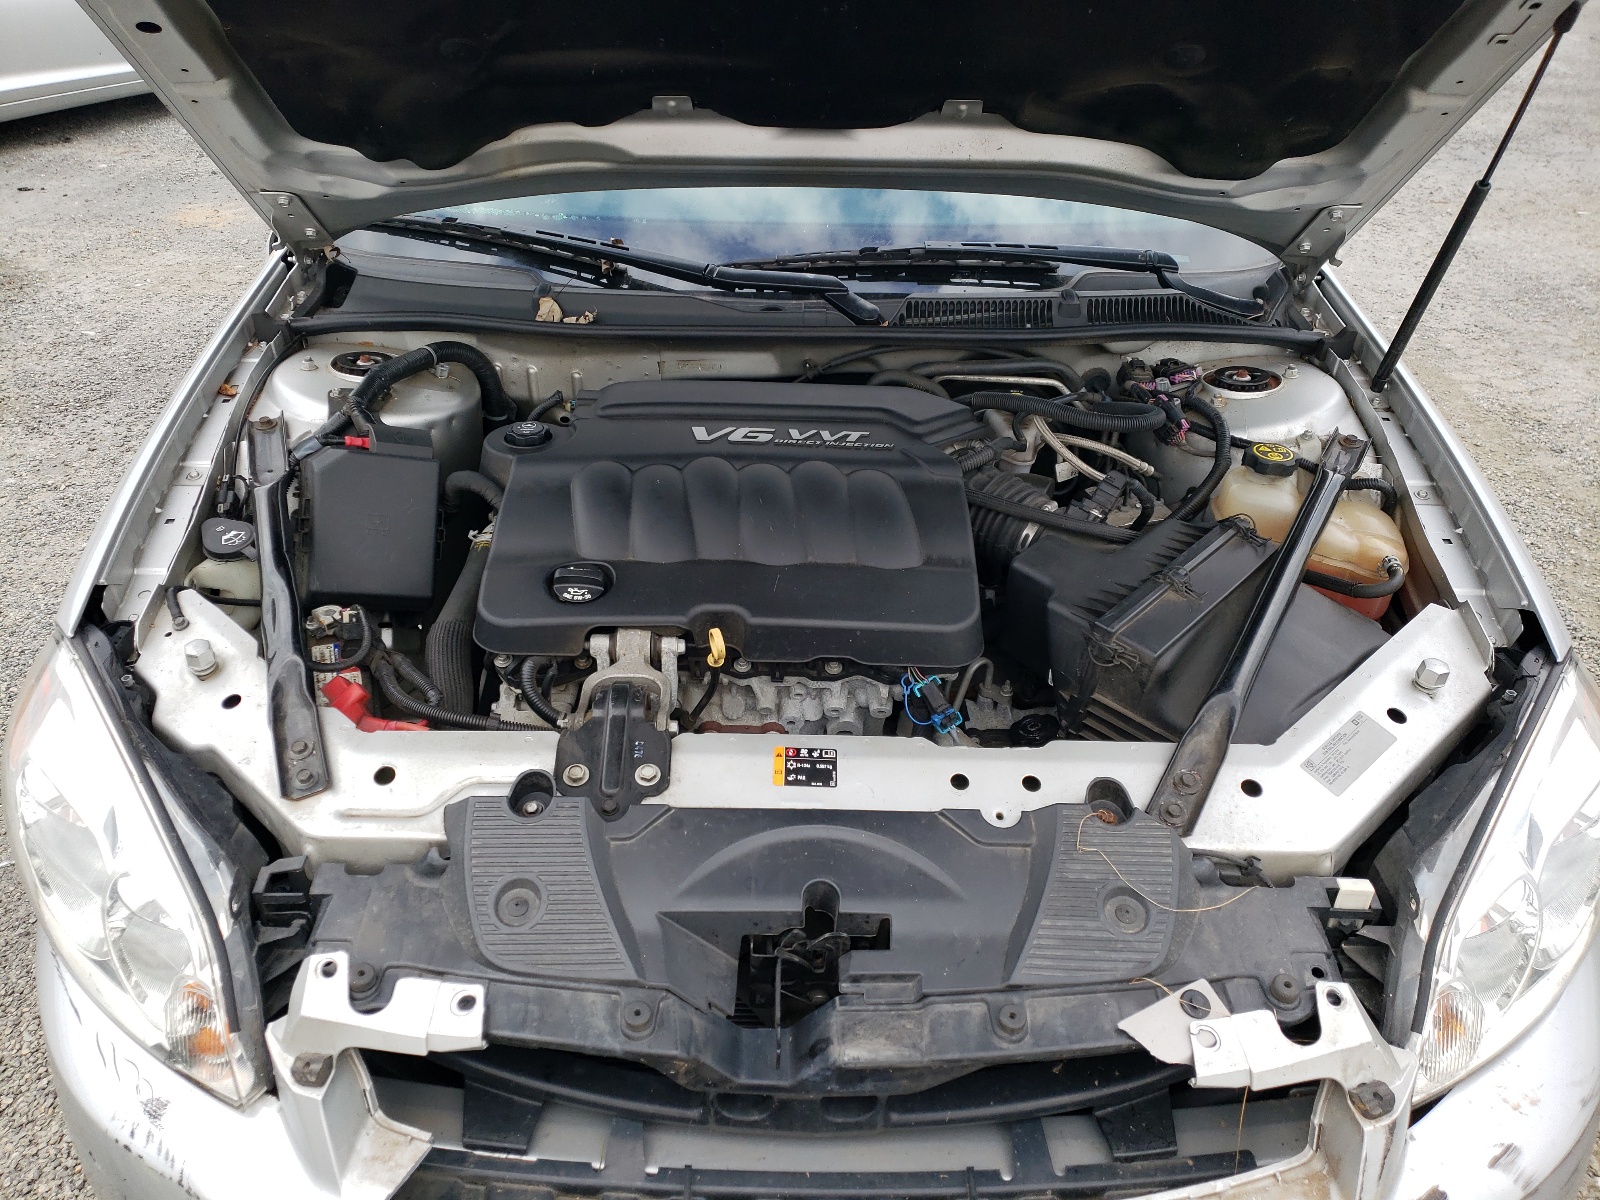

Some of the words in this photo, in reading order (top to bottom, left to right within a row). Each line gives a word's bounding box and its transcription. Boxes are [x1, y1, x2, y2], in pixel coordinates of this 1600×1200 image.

[691, 426, 776, 443] V6
[788, 428, 871, 441] VVT
[774, 438, 821, 446] DIRECT
[825, 440, 895, 448] INJECTION
